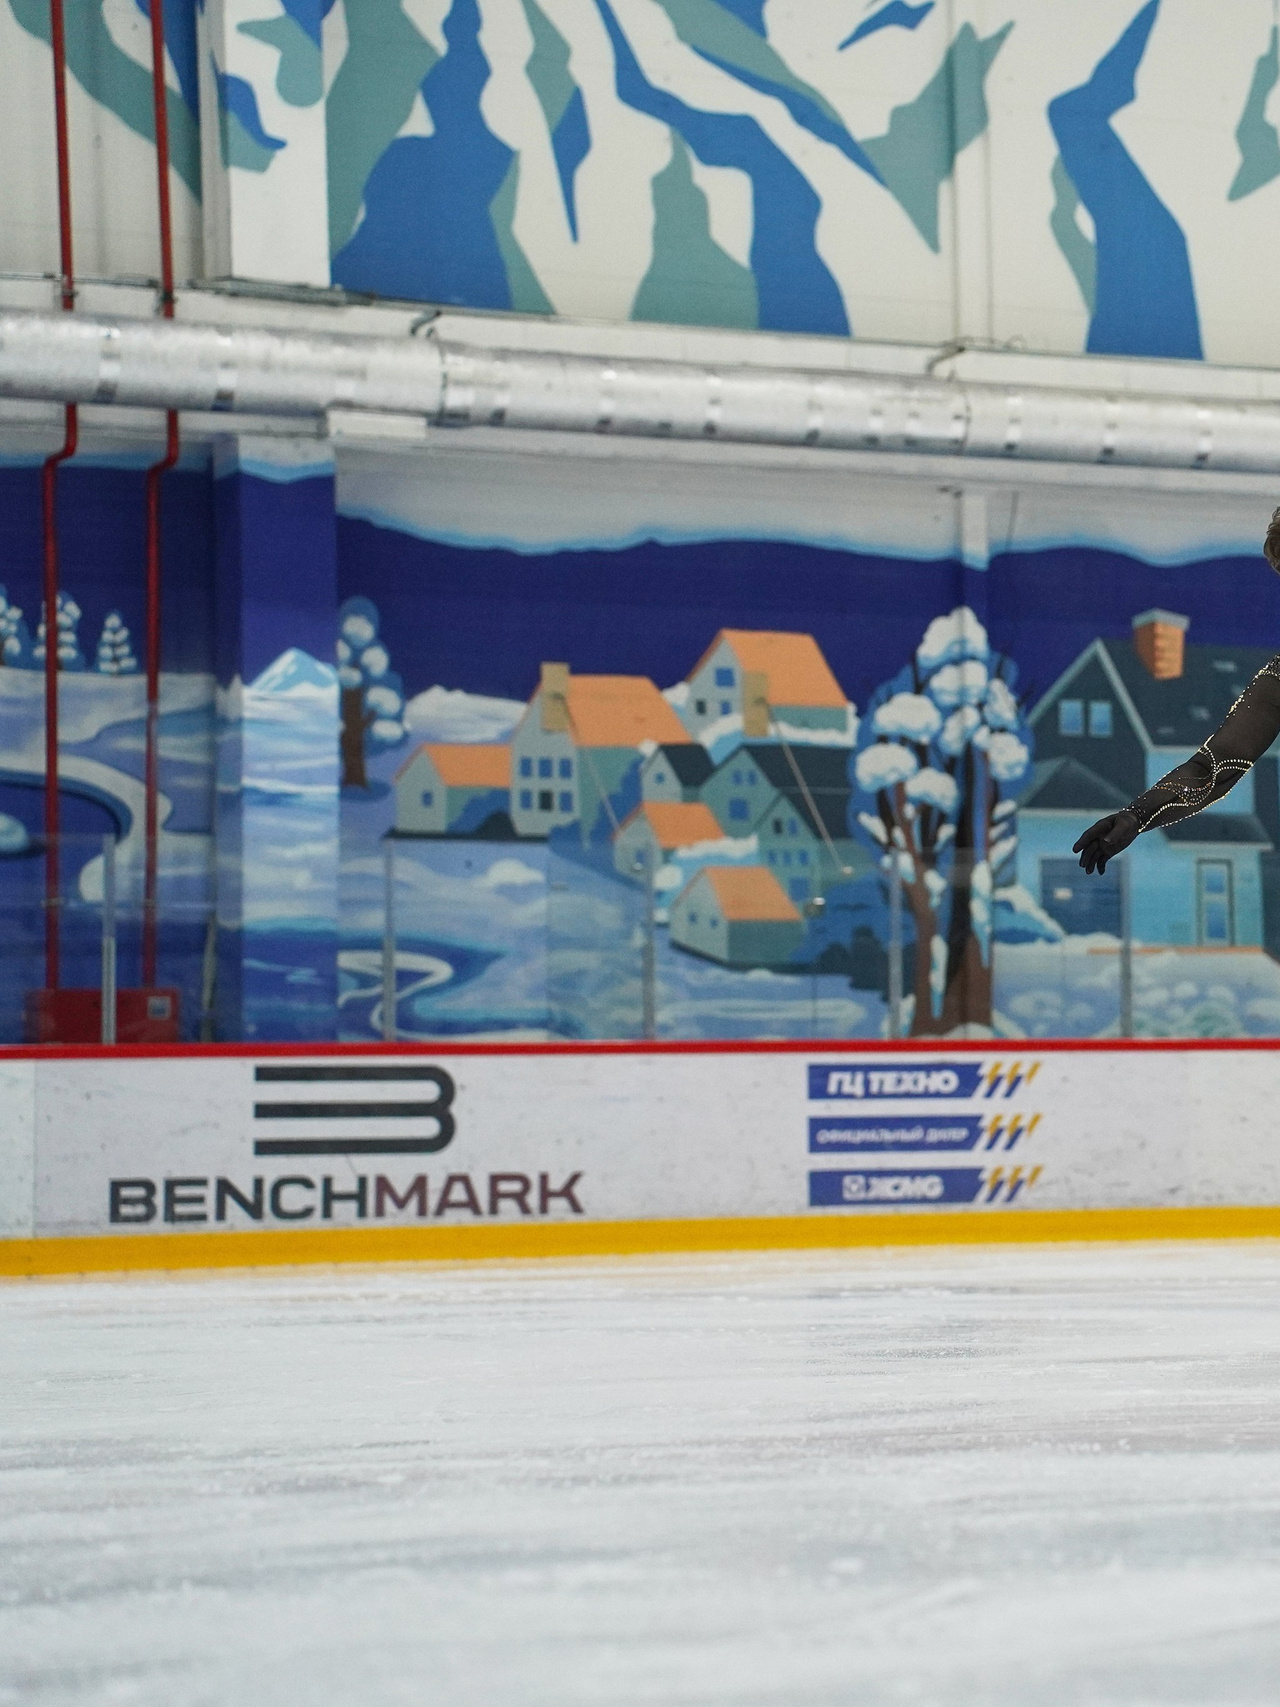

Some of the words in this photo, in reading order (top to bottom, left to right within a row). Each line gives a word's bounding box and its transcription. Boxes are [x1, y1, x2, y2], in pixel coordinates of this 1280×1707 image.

[827, 1070, 865, 1098] ГЦ
[868, 1069, 960, 1095] ТЕХНО
[108, 1170, 586, 1225] BENCHMARK
